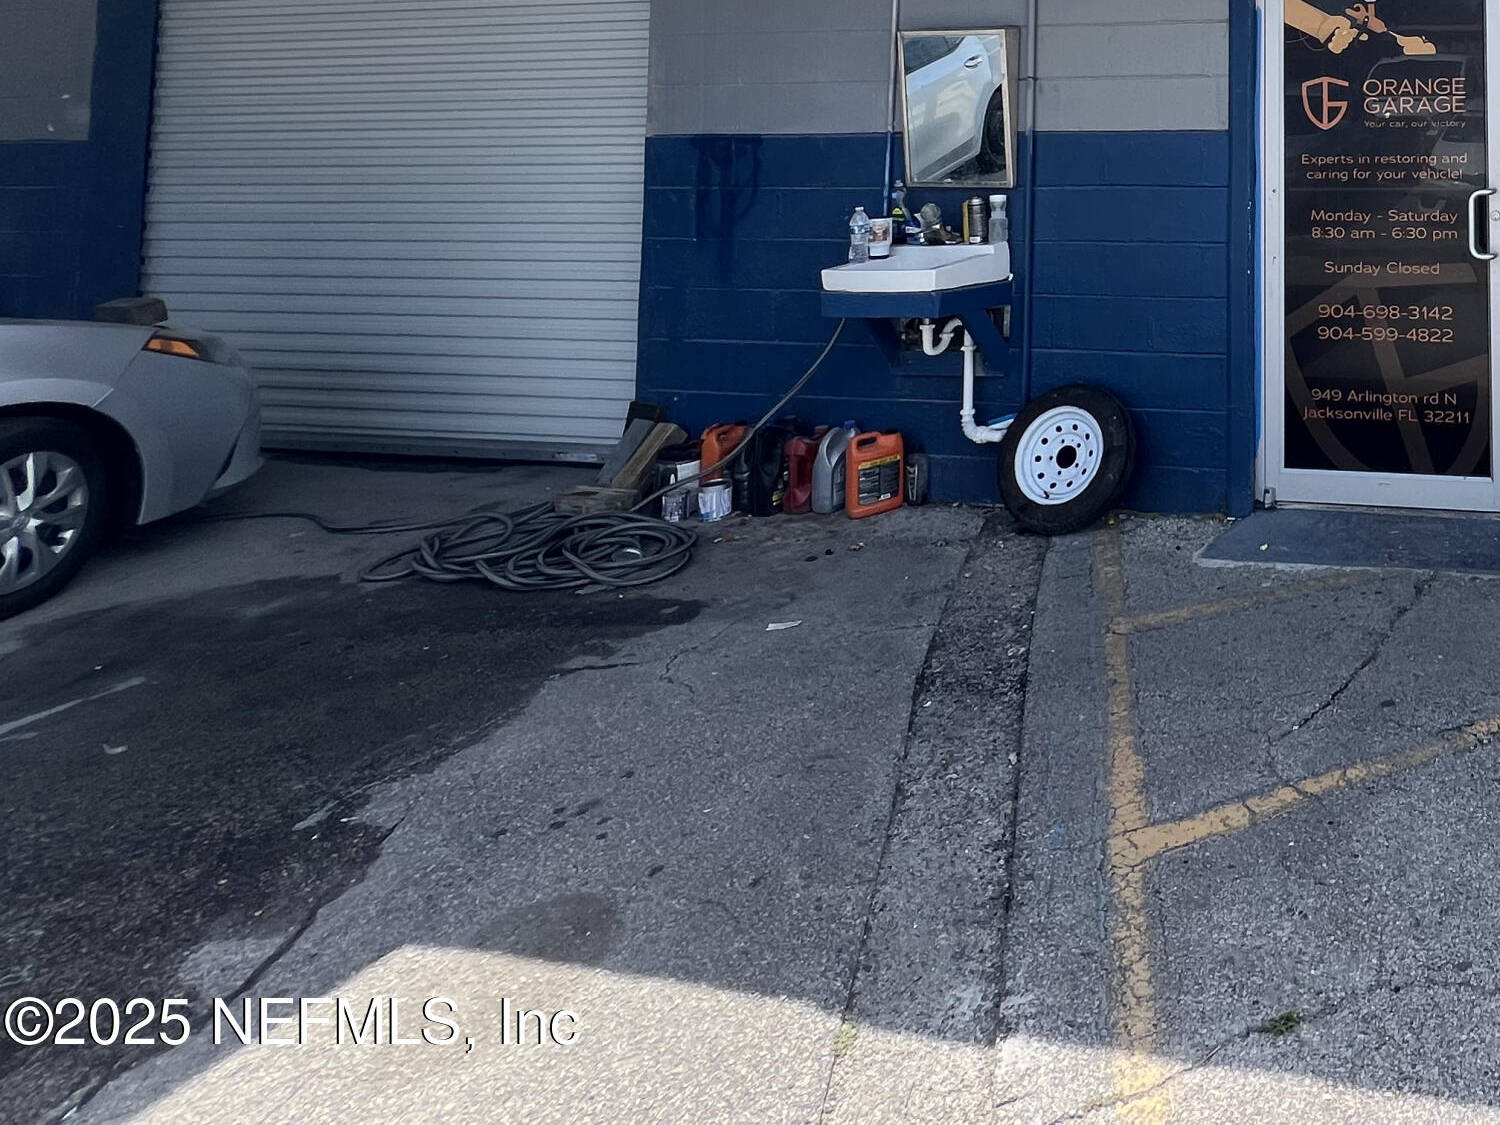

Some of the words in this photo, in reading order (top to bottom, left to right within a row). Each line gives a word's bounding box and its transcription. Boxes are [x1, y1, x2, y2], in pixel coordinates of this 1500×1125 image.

[1363, 78, 1466, 96] ORANGE
[1363, 96, 1466, 114] GARAGE
[1389, 121, 1408, 129] car,
[1431, 120, 1466, 129] victory
[1301, 154, 1353, 165] Experts
[1358, 154, 1370, 164] in
[1375, 154, 1437, 165] restoring
[1441, 153, 1467, 164] and
[1306, 169, 1348, 182] caring
[1353, 168, 1371, 179] for
[1376, 170, 1406, 182] your
[1411, 168, 1463, 179] vehicle!
[1310, 209, 1372, 224] Monday
[1388, 209, 1458, 224] Saturday
[1311, 227, 1345, 239] 8:30
[1350, 229, 1376, 239] am
[1391, 227, 1427, 239] 6:30
[1432, 229, 1458, 242] pm
[1324, 261, 1381, 276] Sunday
[1386, 262, 1440, 274] Closed
[1318, 304, 1453, 320] 904-698-3142
[1317, 326, 1453, 342] 904-599-4822
[1311, 388, 1342, 402] 949
[1347, 389, 1418, 405] Arlington
[1424, 393, 1439, 404] rd
[1444, 393, 1457, 405] N
[1303, 406, 1393, 421] Jacksonville
[1398, 409, 1418, 422] FL
[1424, 410, 1469, 423] 32211
